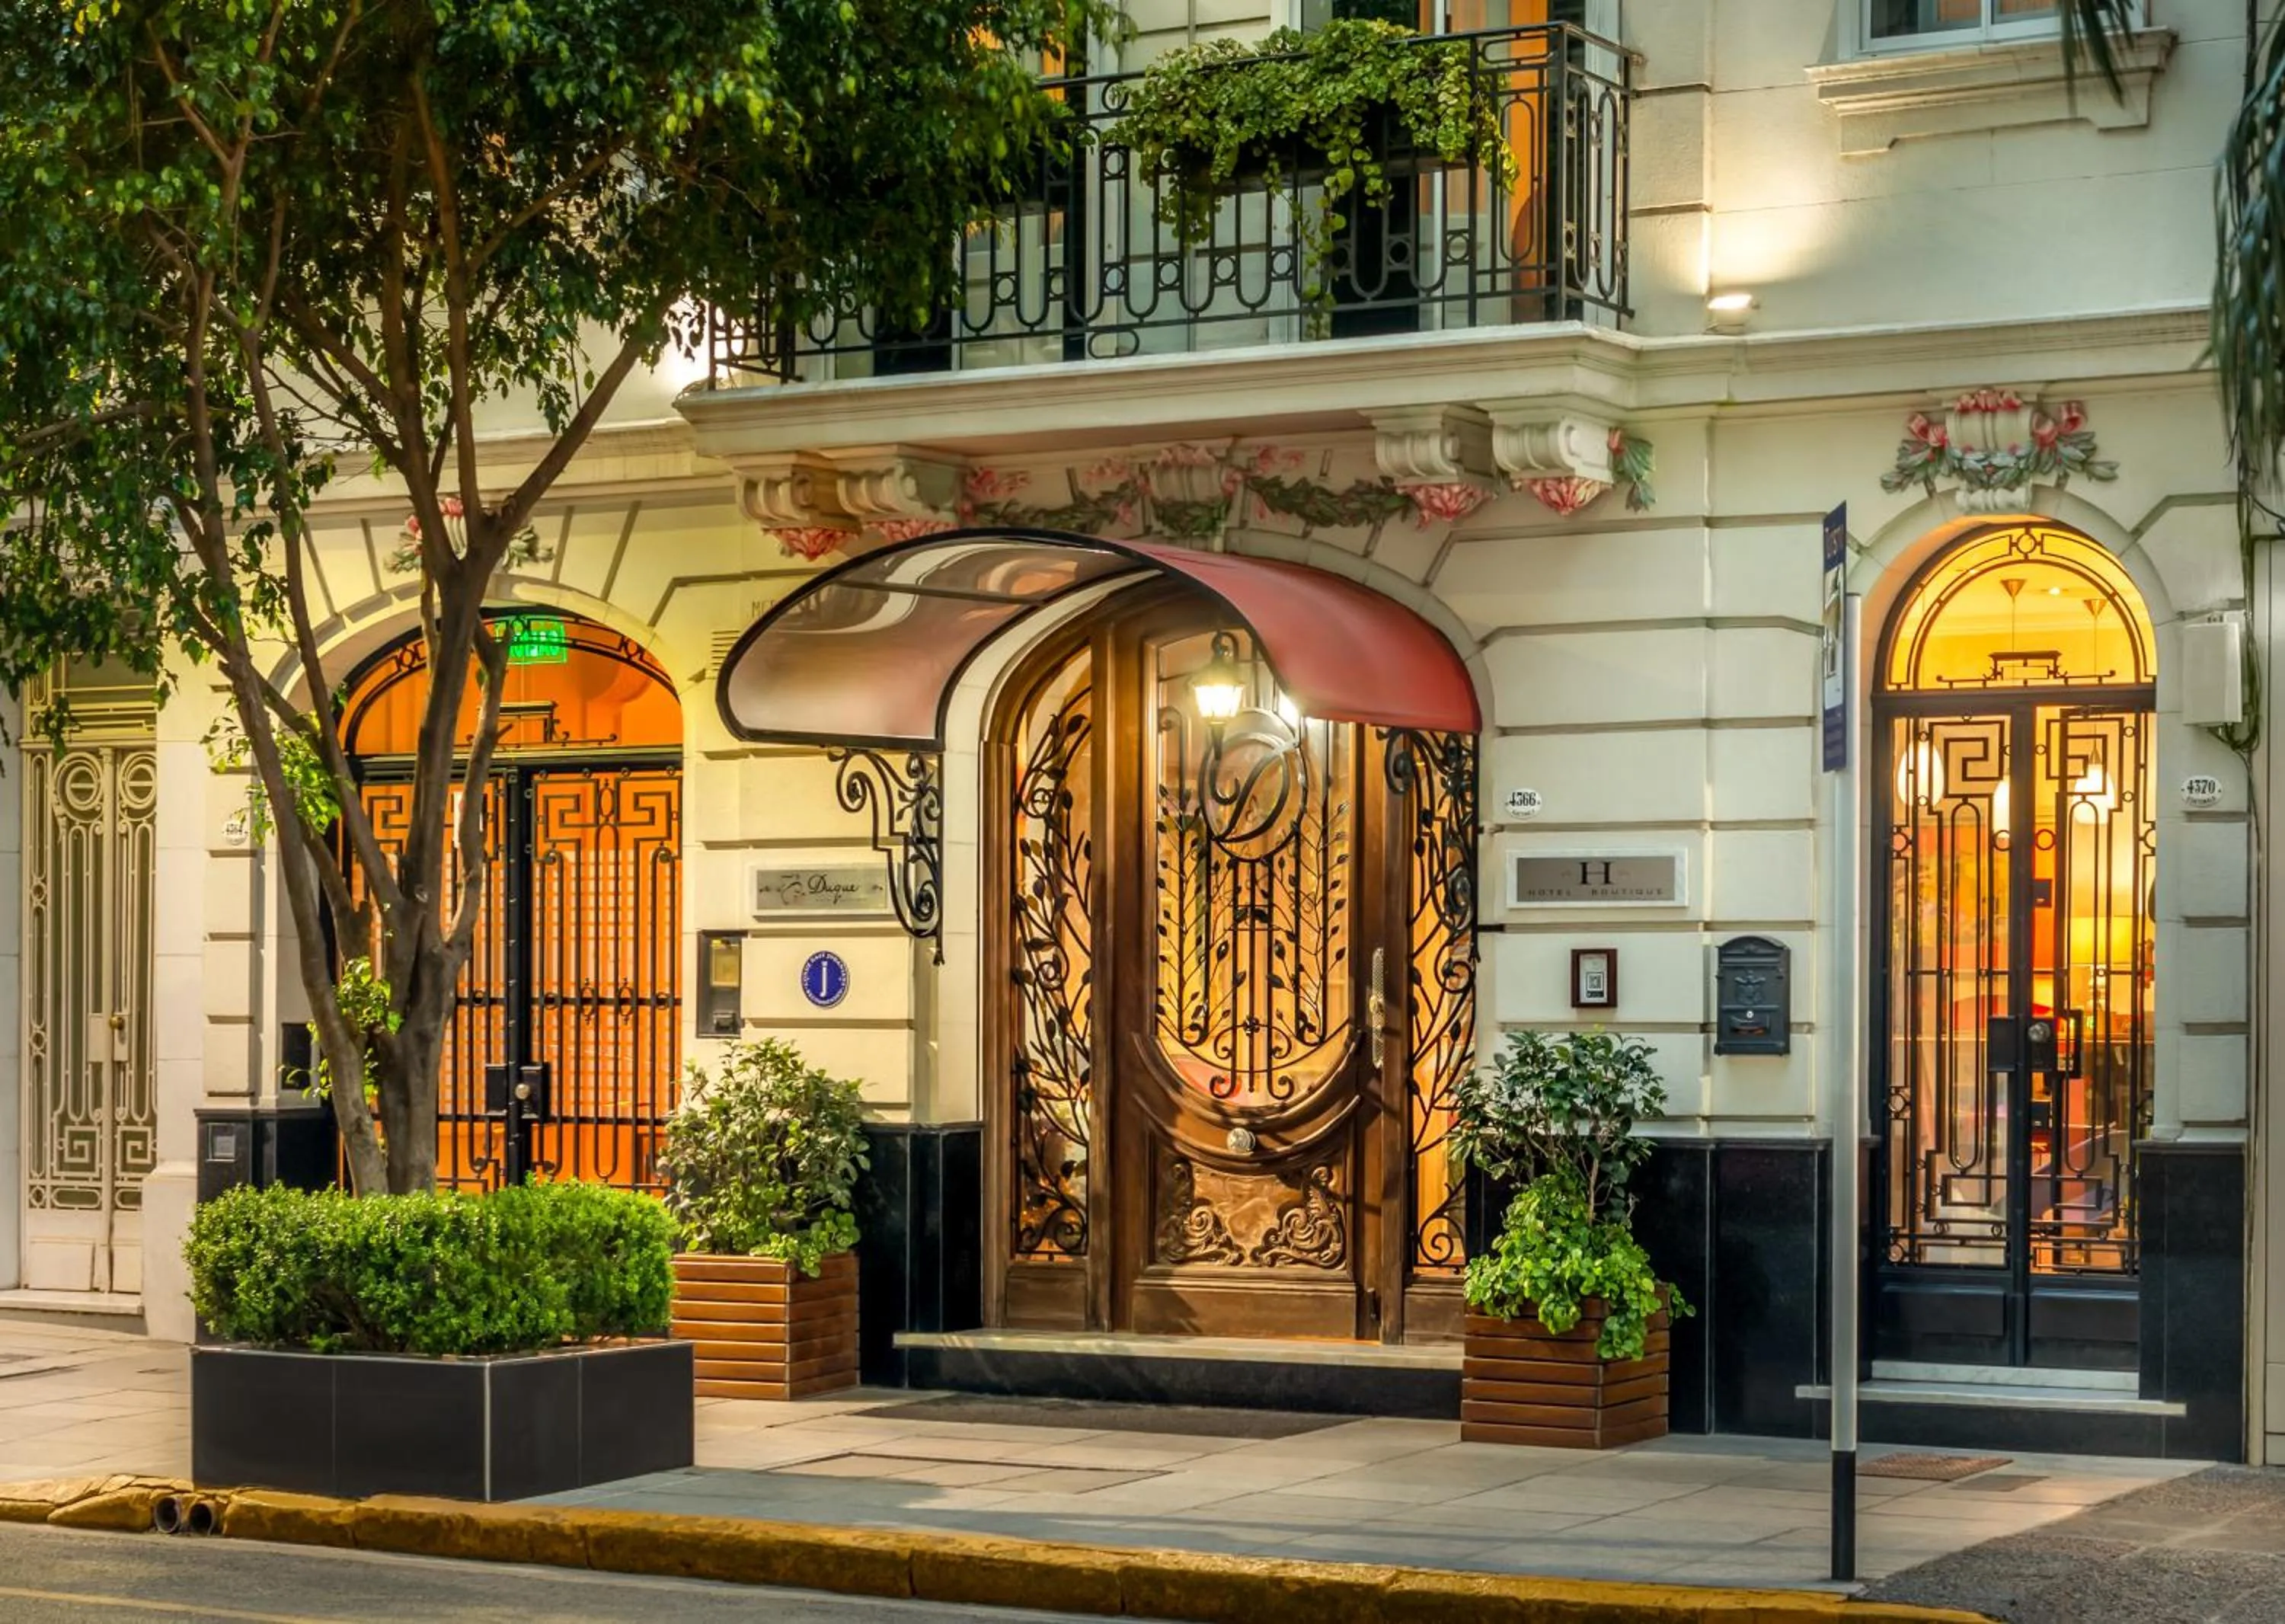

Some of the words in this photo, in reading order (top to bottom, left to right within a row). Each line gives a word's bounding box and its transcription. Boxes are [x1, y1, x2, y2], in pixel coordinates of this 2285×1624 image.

[2187, 779, 2216, 794] 4370
[1509, 791, 1536, 807] 4366
[1579, 862, 1613, 885] H
[807, 873, 859, 904] Duque
[1527, 888, 1571, 897] HOTEL
[1591, 887, 1663, 897] BOUTIQUE
